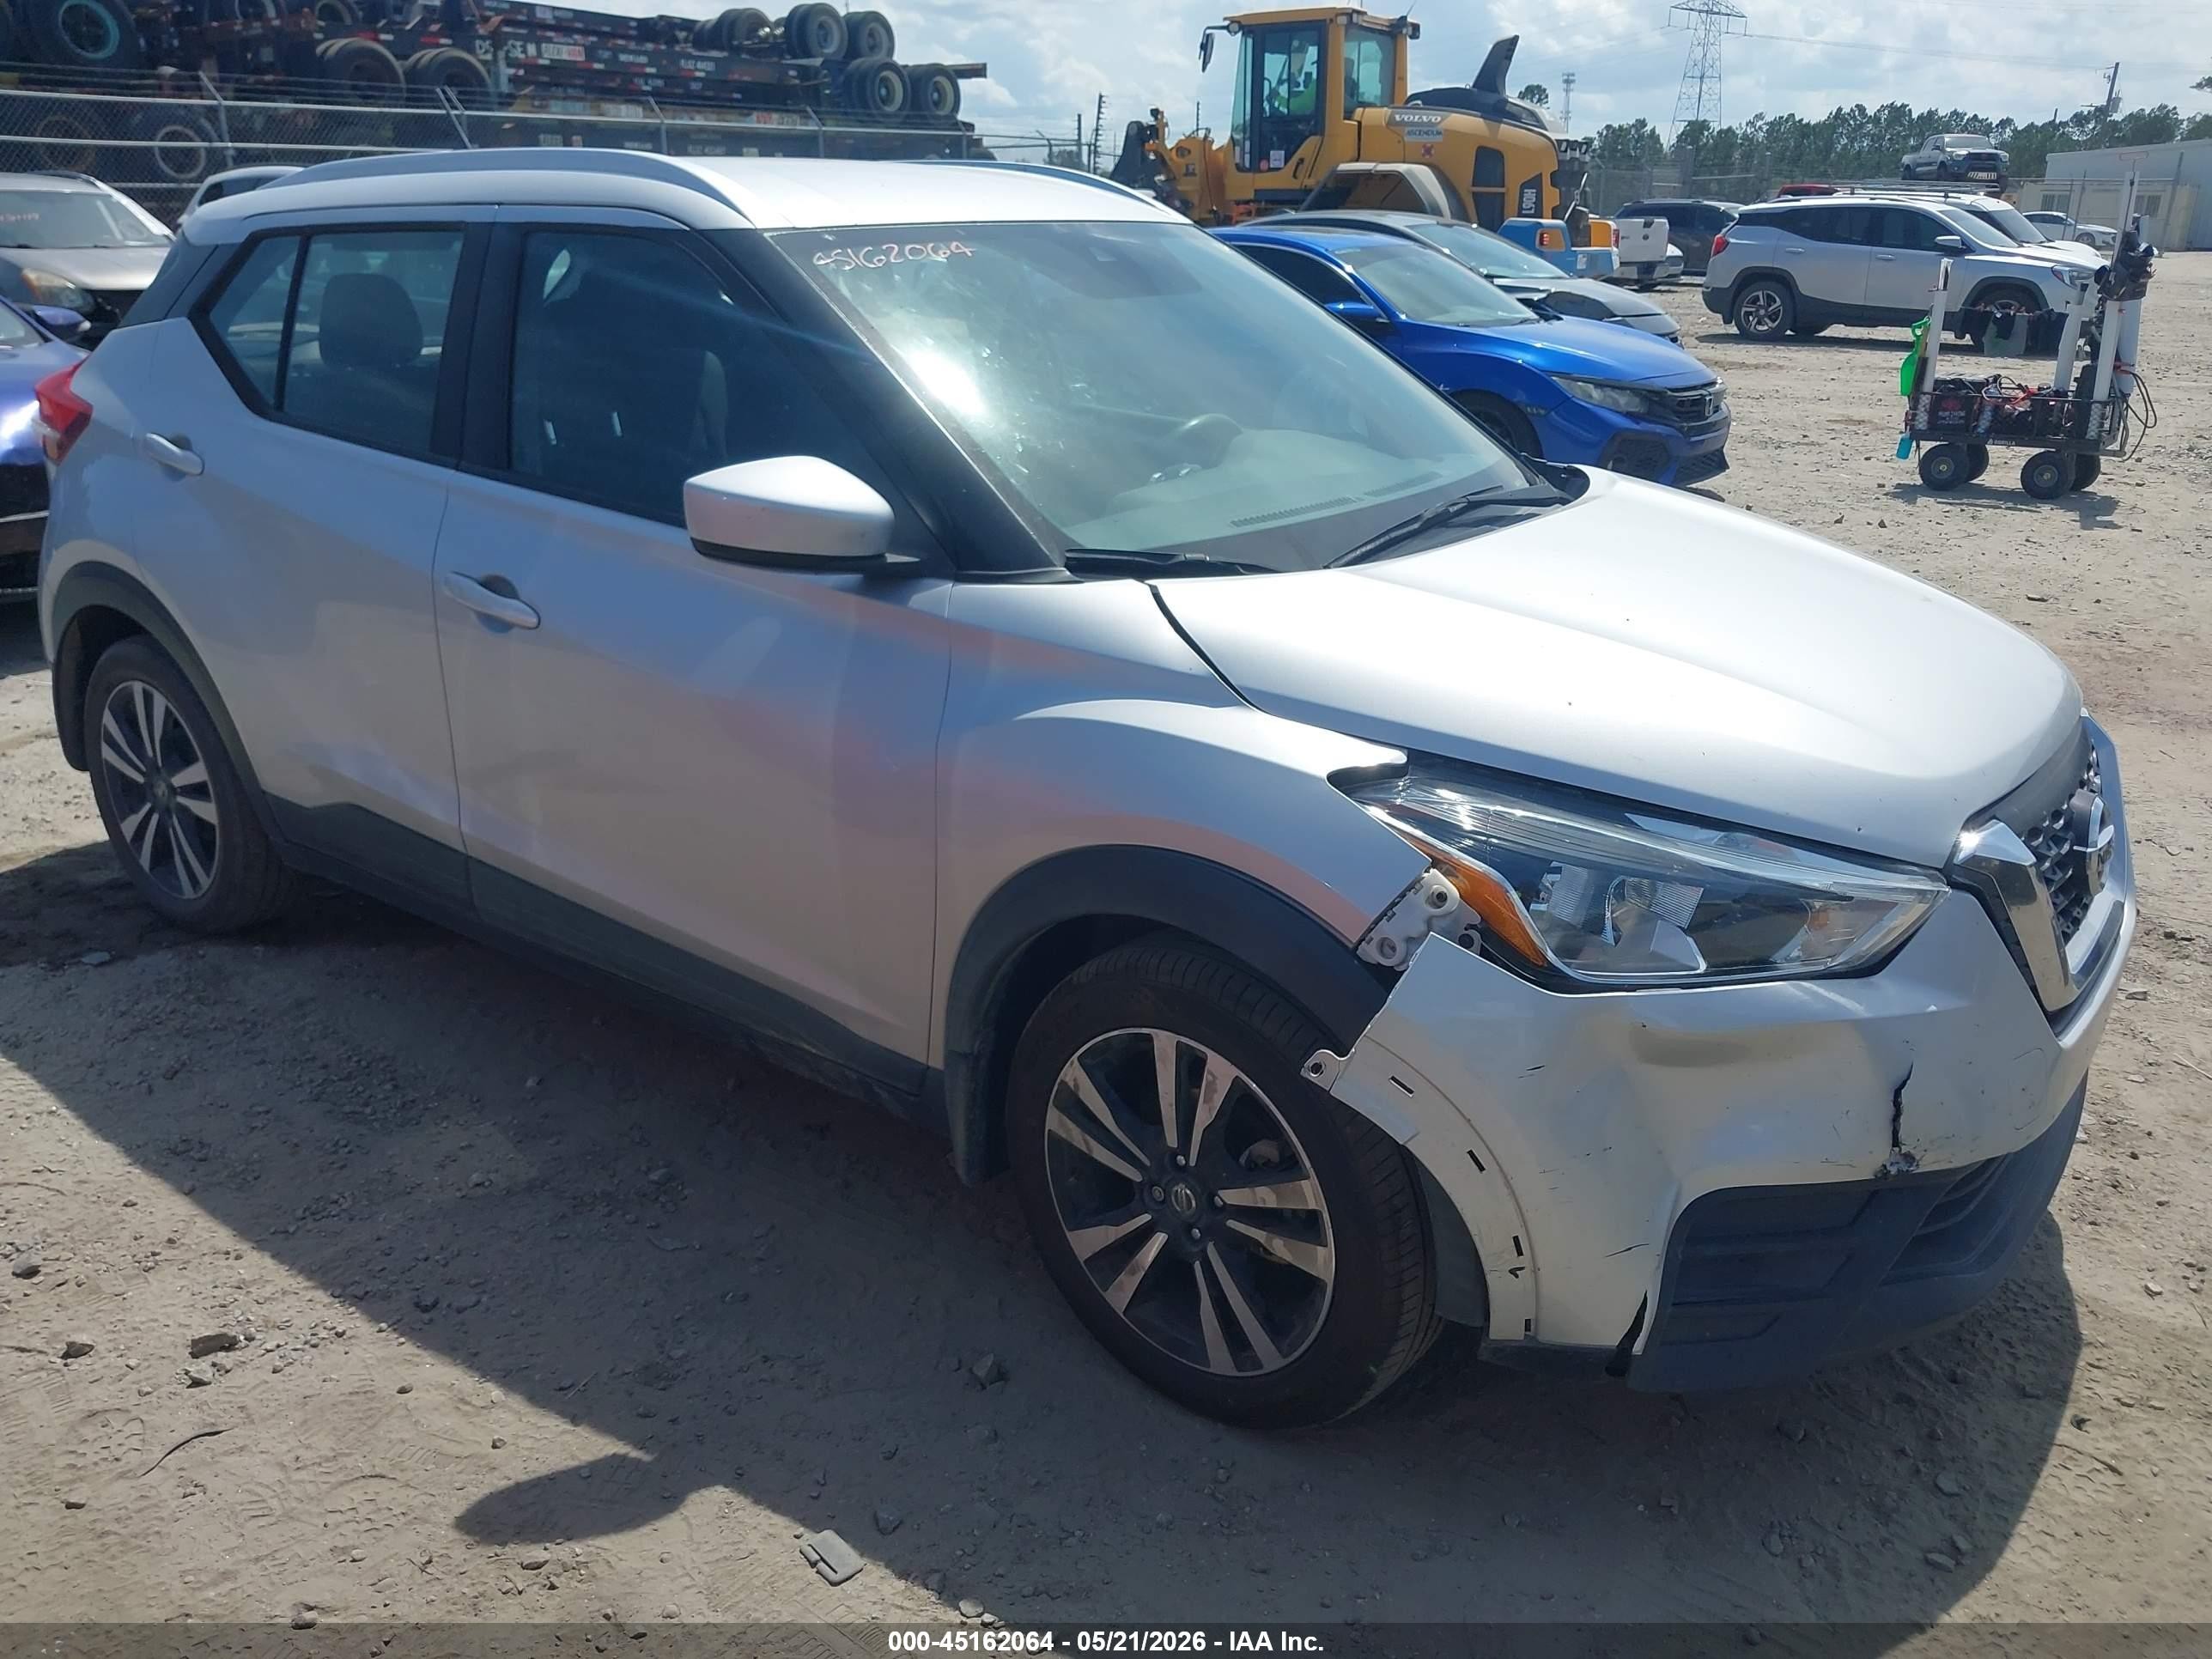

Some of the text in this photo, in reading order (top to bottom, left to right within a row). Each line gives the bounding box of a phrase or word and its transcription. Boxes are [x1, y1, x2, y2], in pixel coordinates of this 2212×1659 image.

[1395, 113, 1442, 123] VOLVO
[1522, 188, 1537, 214] L90H
[812, 241, 976, 270] 45162064
